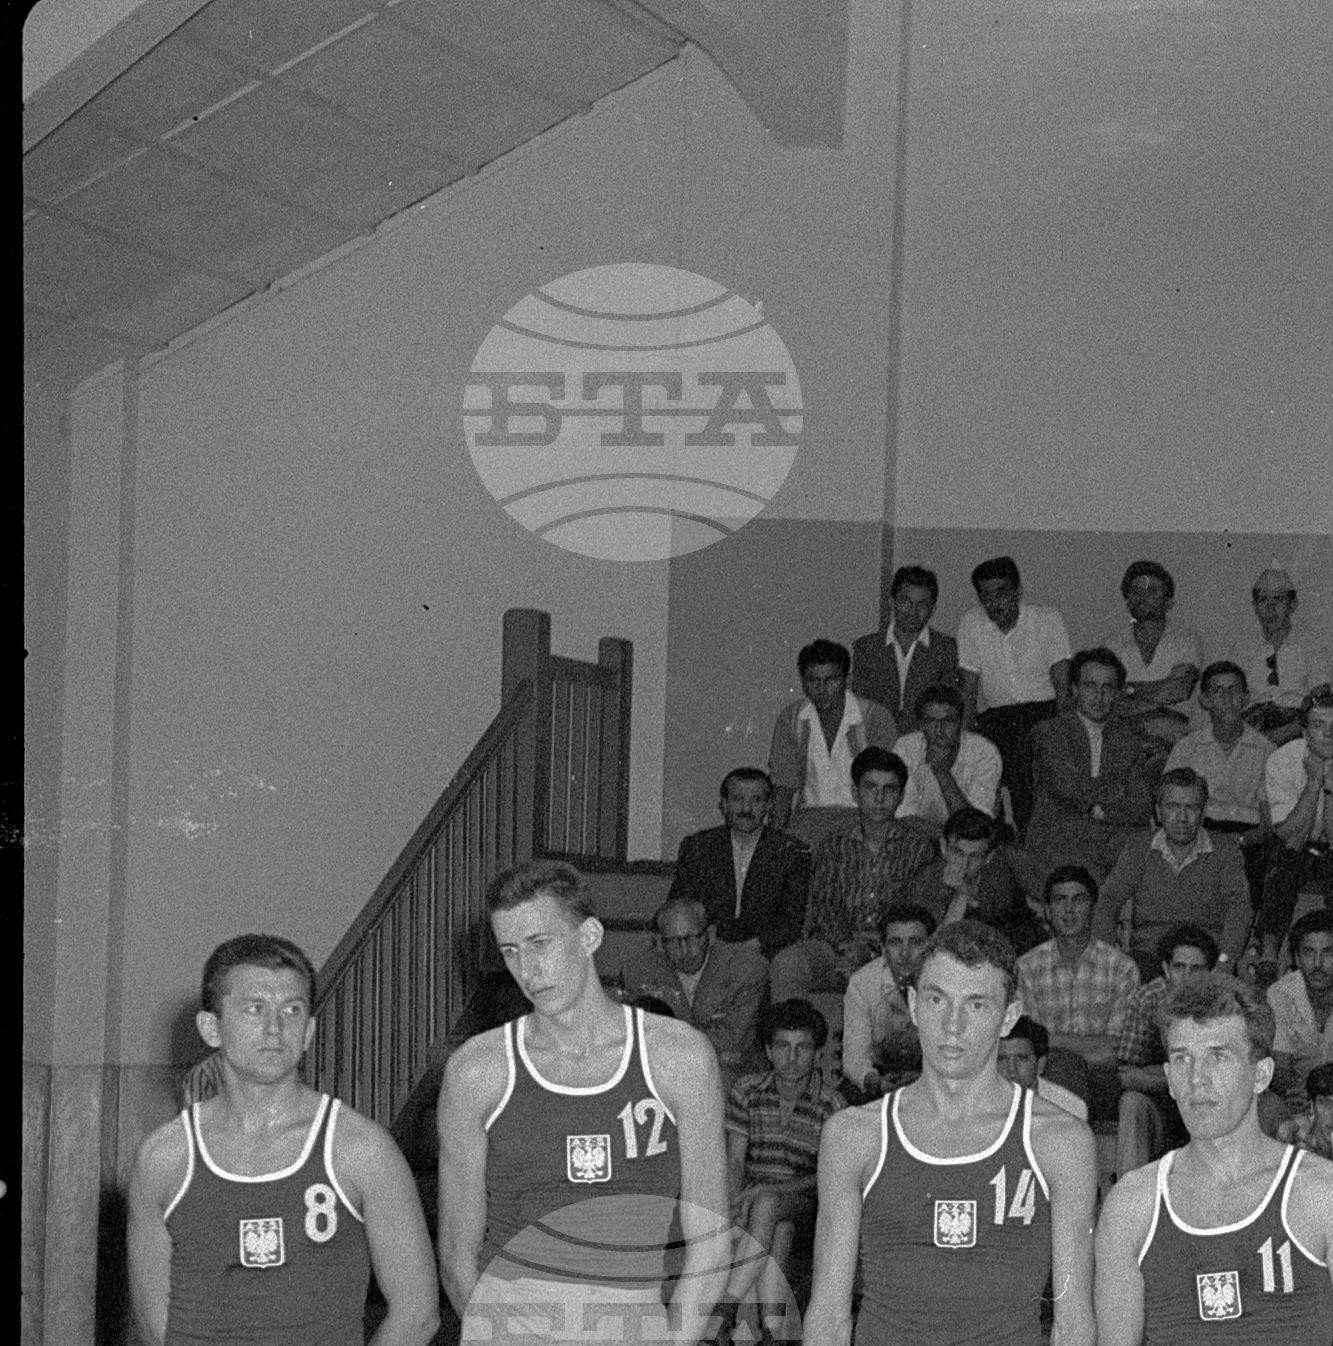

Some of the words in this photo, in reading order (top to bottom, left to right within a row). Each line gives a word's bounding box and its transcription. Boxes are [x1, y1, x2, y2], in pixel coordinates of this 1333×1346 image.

[618, 1099, 667, 1158] 12
[305, 1183, 337, 1242] 8
[989, 1165, 1035, 1224] 14
[1257, 1237, 1294, 1292] 11
